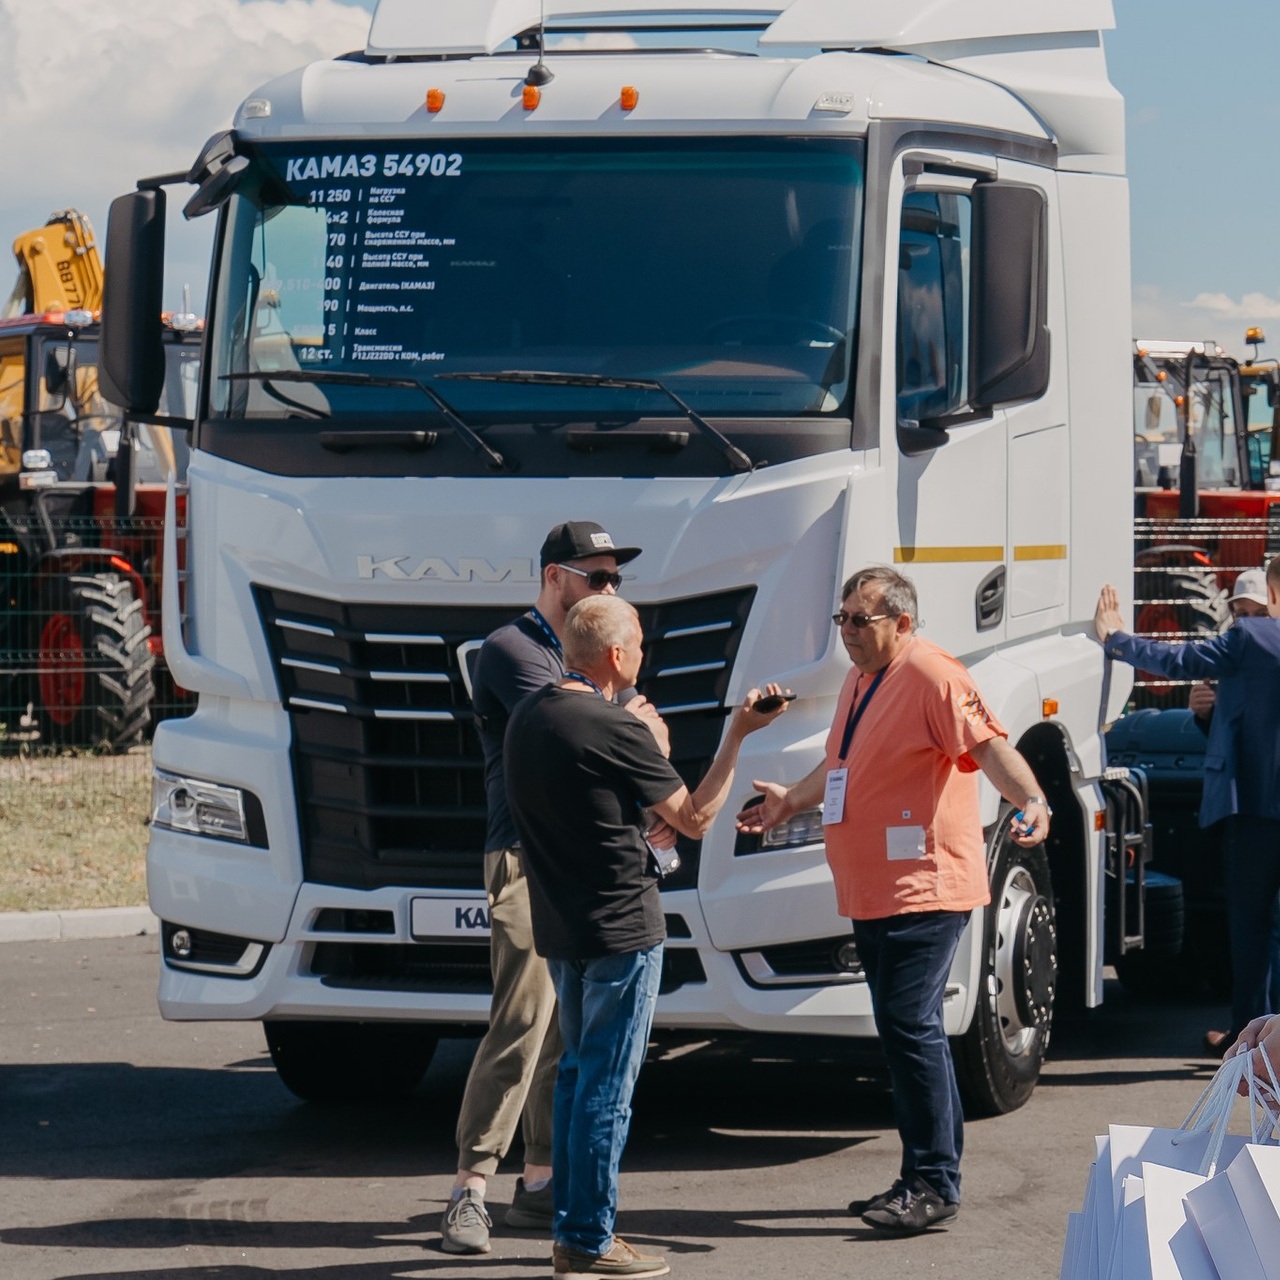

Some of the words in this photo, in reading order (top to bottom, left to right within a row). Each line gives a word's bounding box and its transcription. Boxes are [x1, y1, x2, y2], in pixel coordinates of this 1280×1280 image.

[286, 155, 376, 181] КАМАЗ
[383, 154, 463, 177] 54902
[309, 190, 323, 203] 11
[327, 189, 351, 202] 250
[369, 187, 406, 196] Нагрузка
[380, 195, 396, 203] ССУ
[367, 216, 401, 224] формула
[411, 231, 425, 239] при
[363, 253, 391, 261] Высота
[408, 253, 423, 261] при
[362, 260, 390, 268] полной
[359, 281, 400, 291] Двигатель
[357, 304, 398, 313] Мощность,
[328, 324, 336, 335] 5
[354, 327, 377, 335] Класс
[353, 343, 402, 352] Трансмиссия
[301, 348, 315, 359] 12
[317, 348, 333, 359] ст.
